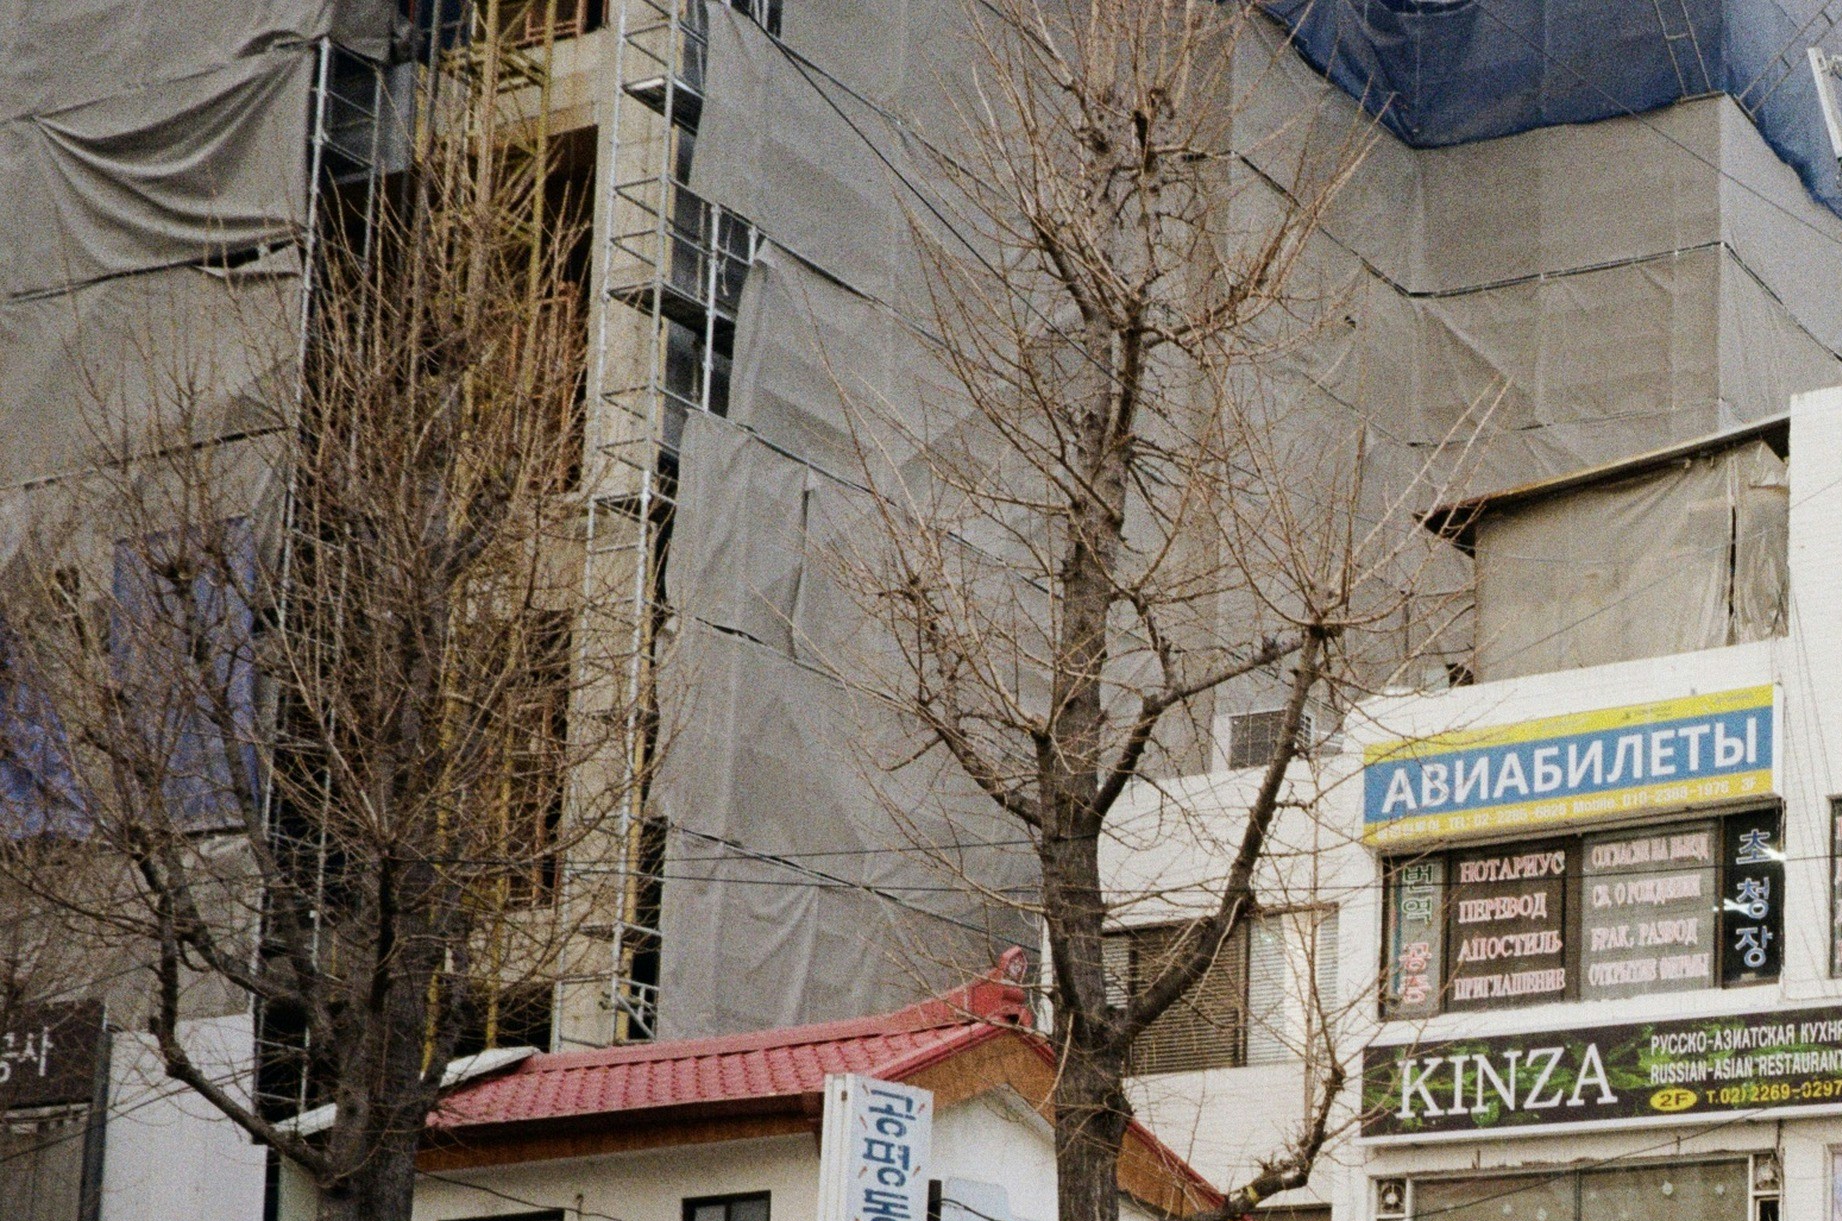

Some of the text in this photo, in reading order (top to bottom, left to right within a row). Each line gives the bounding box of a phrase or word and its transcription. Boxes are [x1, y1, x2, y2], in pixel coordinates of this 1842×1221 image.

[1381, 716, 1758, 814] АВИАБИЛЕТЫ
[1459, 850, 1566, 884] НОТАРИУС
[1402, 863, 1434, 925] 번역
[1458, 891, 1548, 924] ПЕРЕВОД
[1735, 828, 1773, 969] 초청장
[1457, 929, 1564, 962] АПОСТИЛЬ
[1637, 917, 1699, 946] РАЗВОД
[1651, 1023, 1796, 1056] РУССКО-АЗИАТСКАЯ
[1394, 1042, 1618, 1121] KINZA
[1650, 1055, 1753, 1084] RUSSIAN-ASIAN
[1659, 1092, 1690, 1107] 2F
